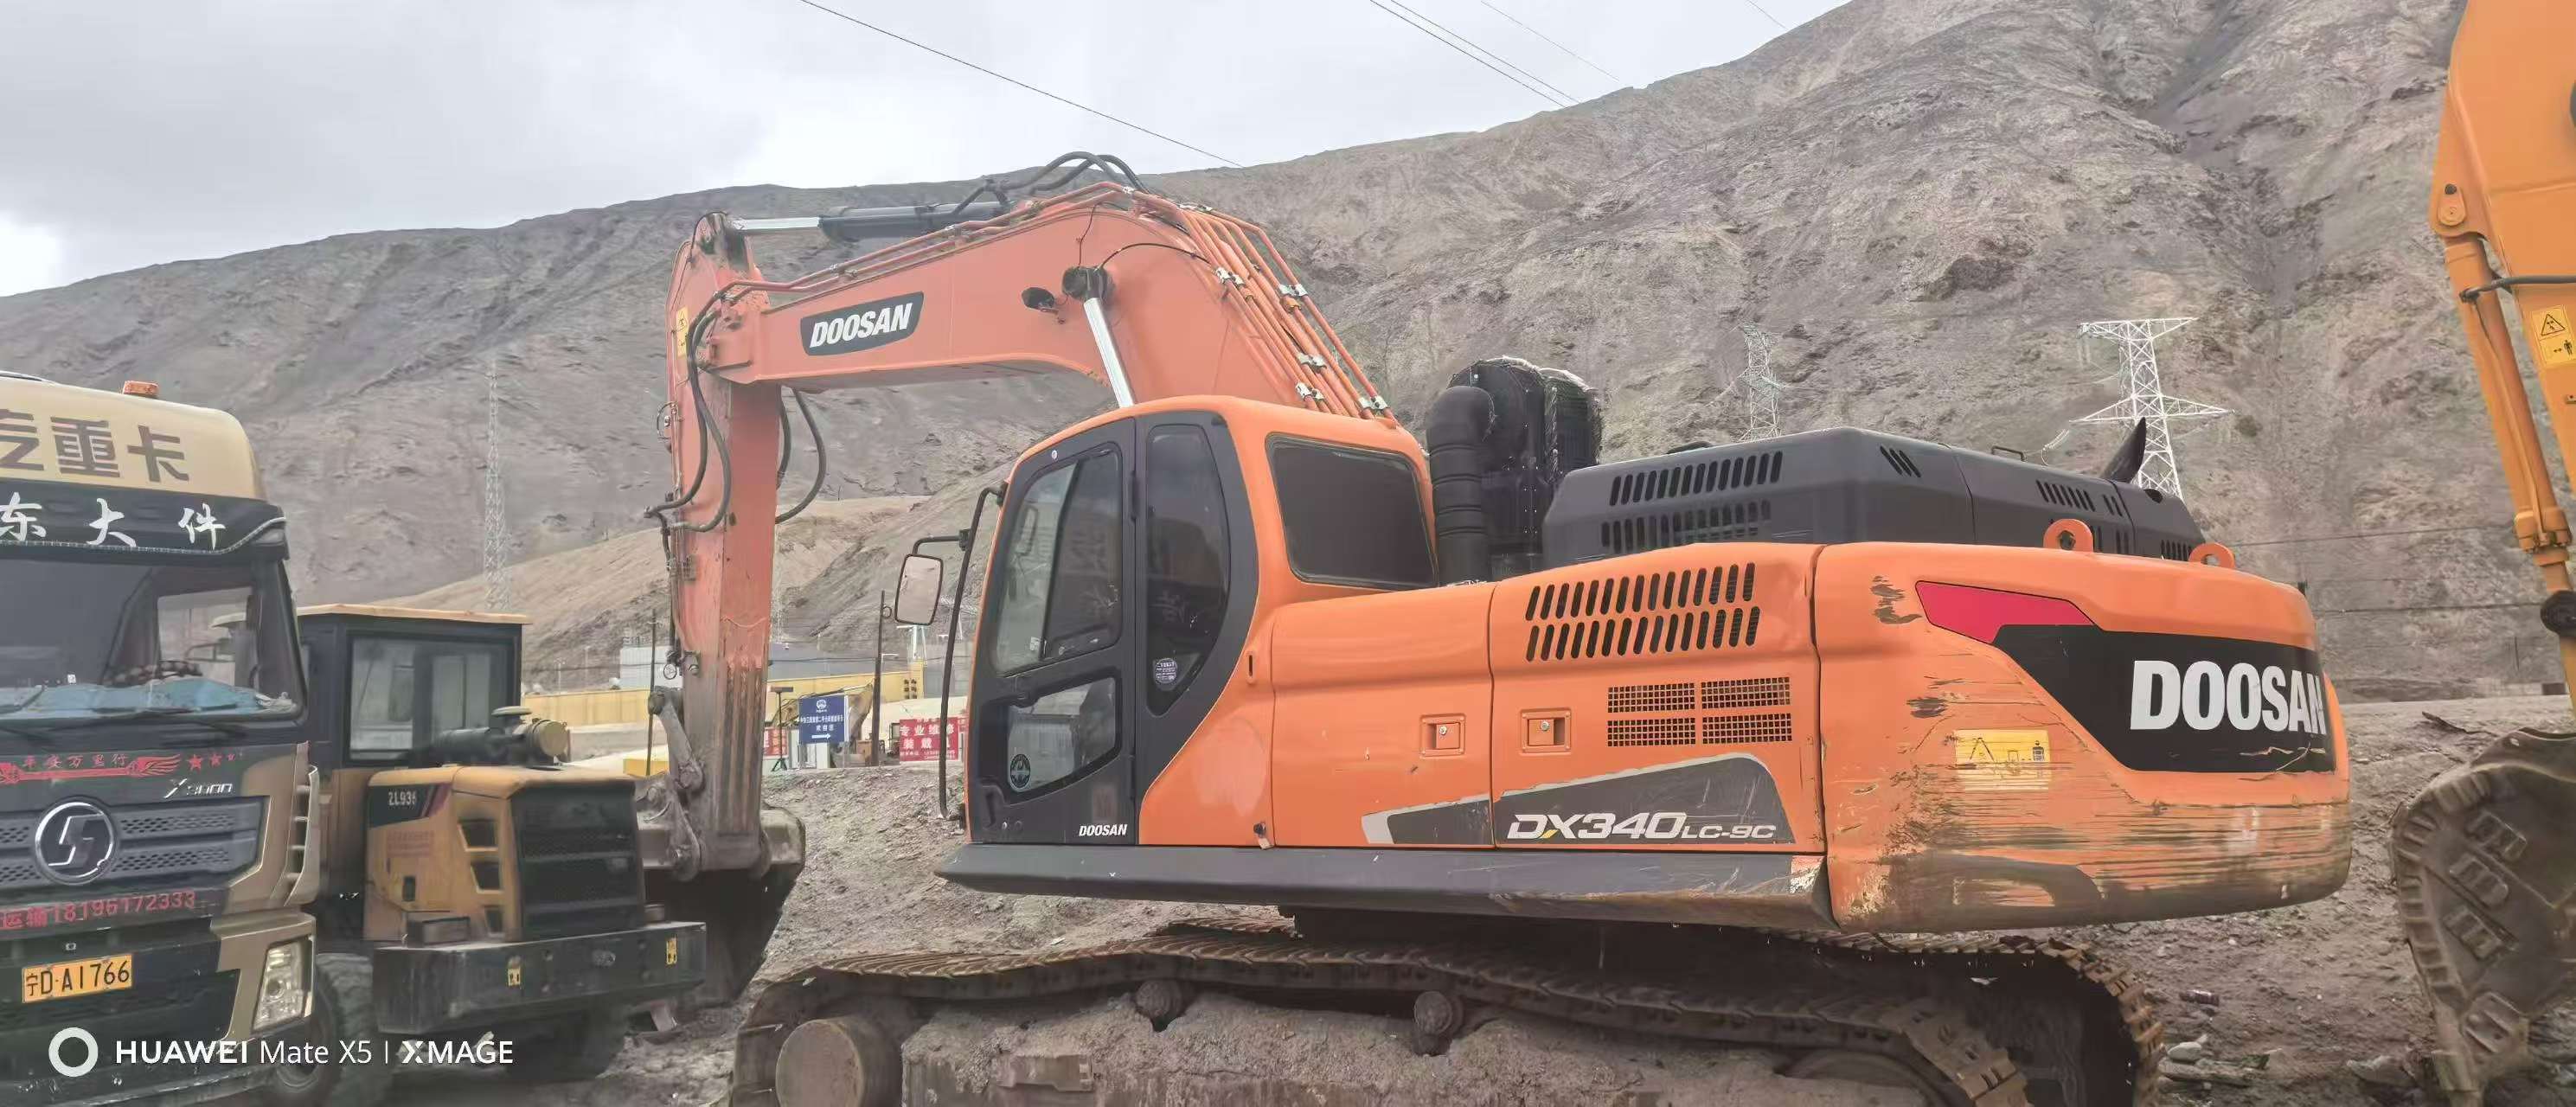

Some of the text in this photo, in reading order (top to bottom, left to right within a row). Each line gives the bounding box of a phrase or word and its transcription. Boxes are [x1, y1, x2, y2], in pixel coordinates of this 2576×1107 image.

[809, 303, 913, 348] DOOSAN
[2131, 661, 2327, 735] DOOSAN
[1079, 824, 1128, 836] DOOSAN
